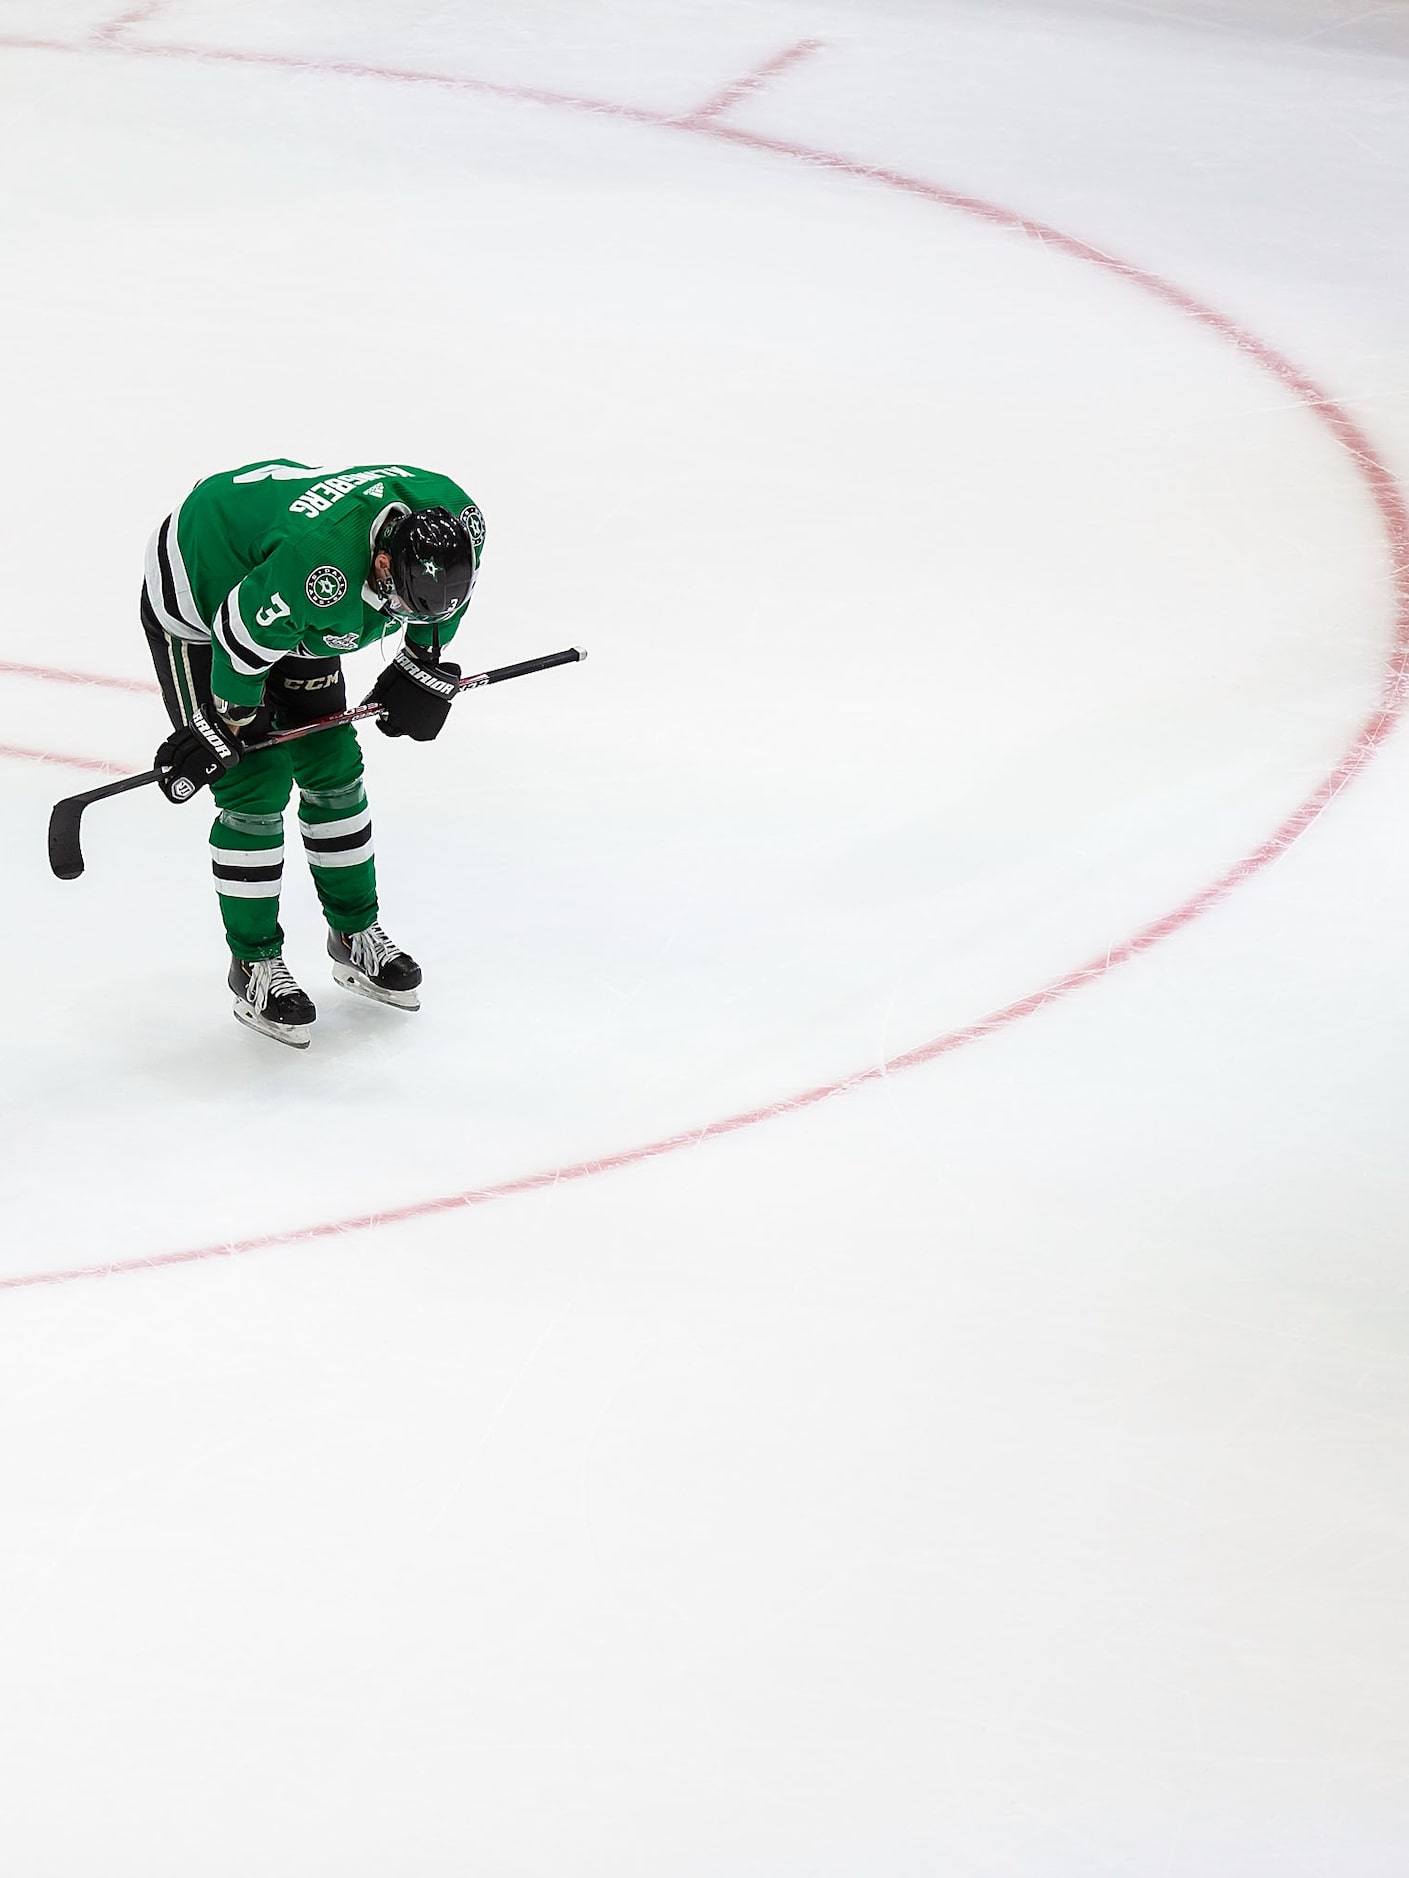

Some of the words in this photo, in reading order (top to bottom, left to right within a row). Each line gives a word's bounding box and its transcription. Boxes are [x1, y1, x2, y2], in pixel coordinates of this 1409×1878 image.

[255, 592, 291, 627] 3
[283, 670, 340, 691] CCM
[192, 708, 232, 759] RRIOR
[205, 763, 218, 775] 3
